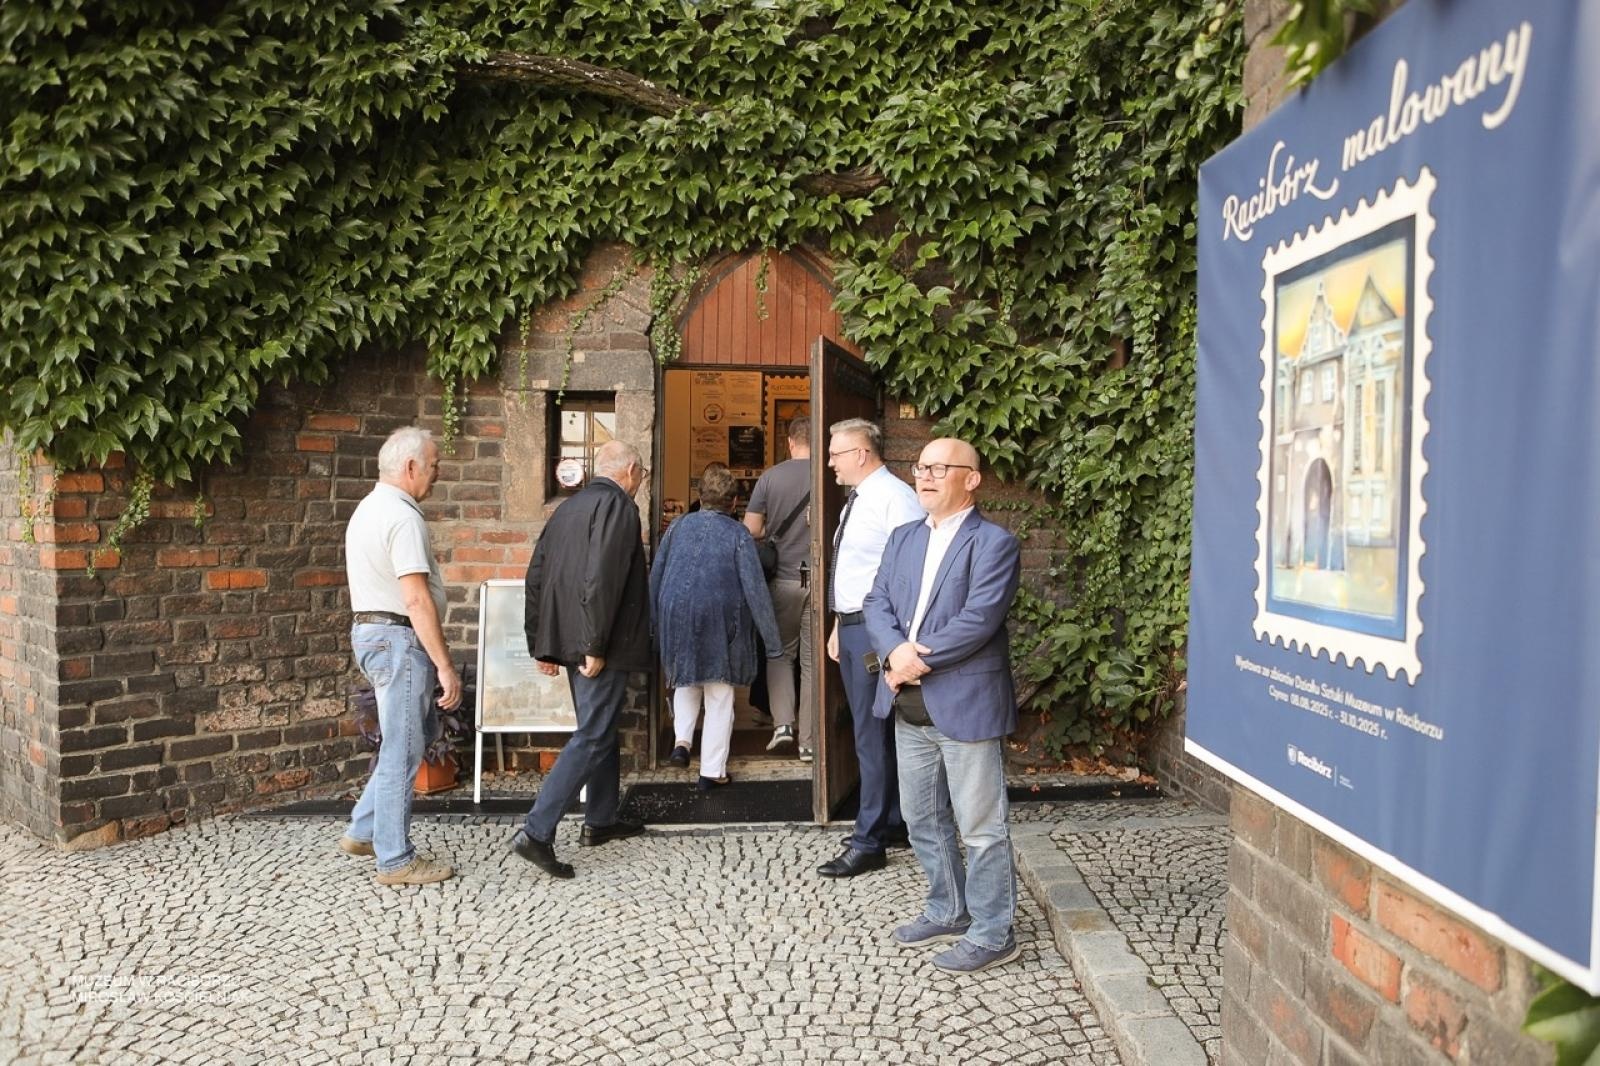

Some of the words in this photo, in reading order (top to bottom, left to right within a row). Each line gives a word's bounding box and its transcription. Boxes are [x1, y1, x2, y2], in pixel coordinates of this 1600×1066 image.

[1223, 140, 1339, 241] Racibórz
[1341, 21, 1532, 172] malowany
[1345, 690, 1382, 717] Muzeum
[1384, 708, 1395, 720] w
[1396, 707, 1443, 740] Raciborzu
[1297, 749, 1332, 779] Racibórz
